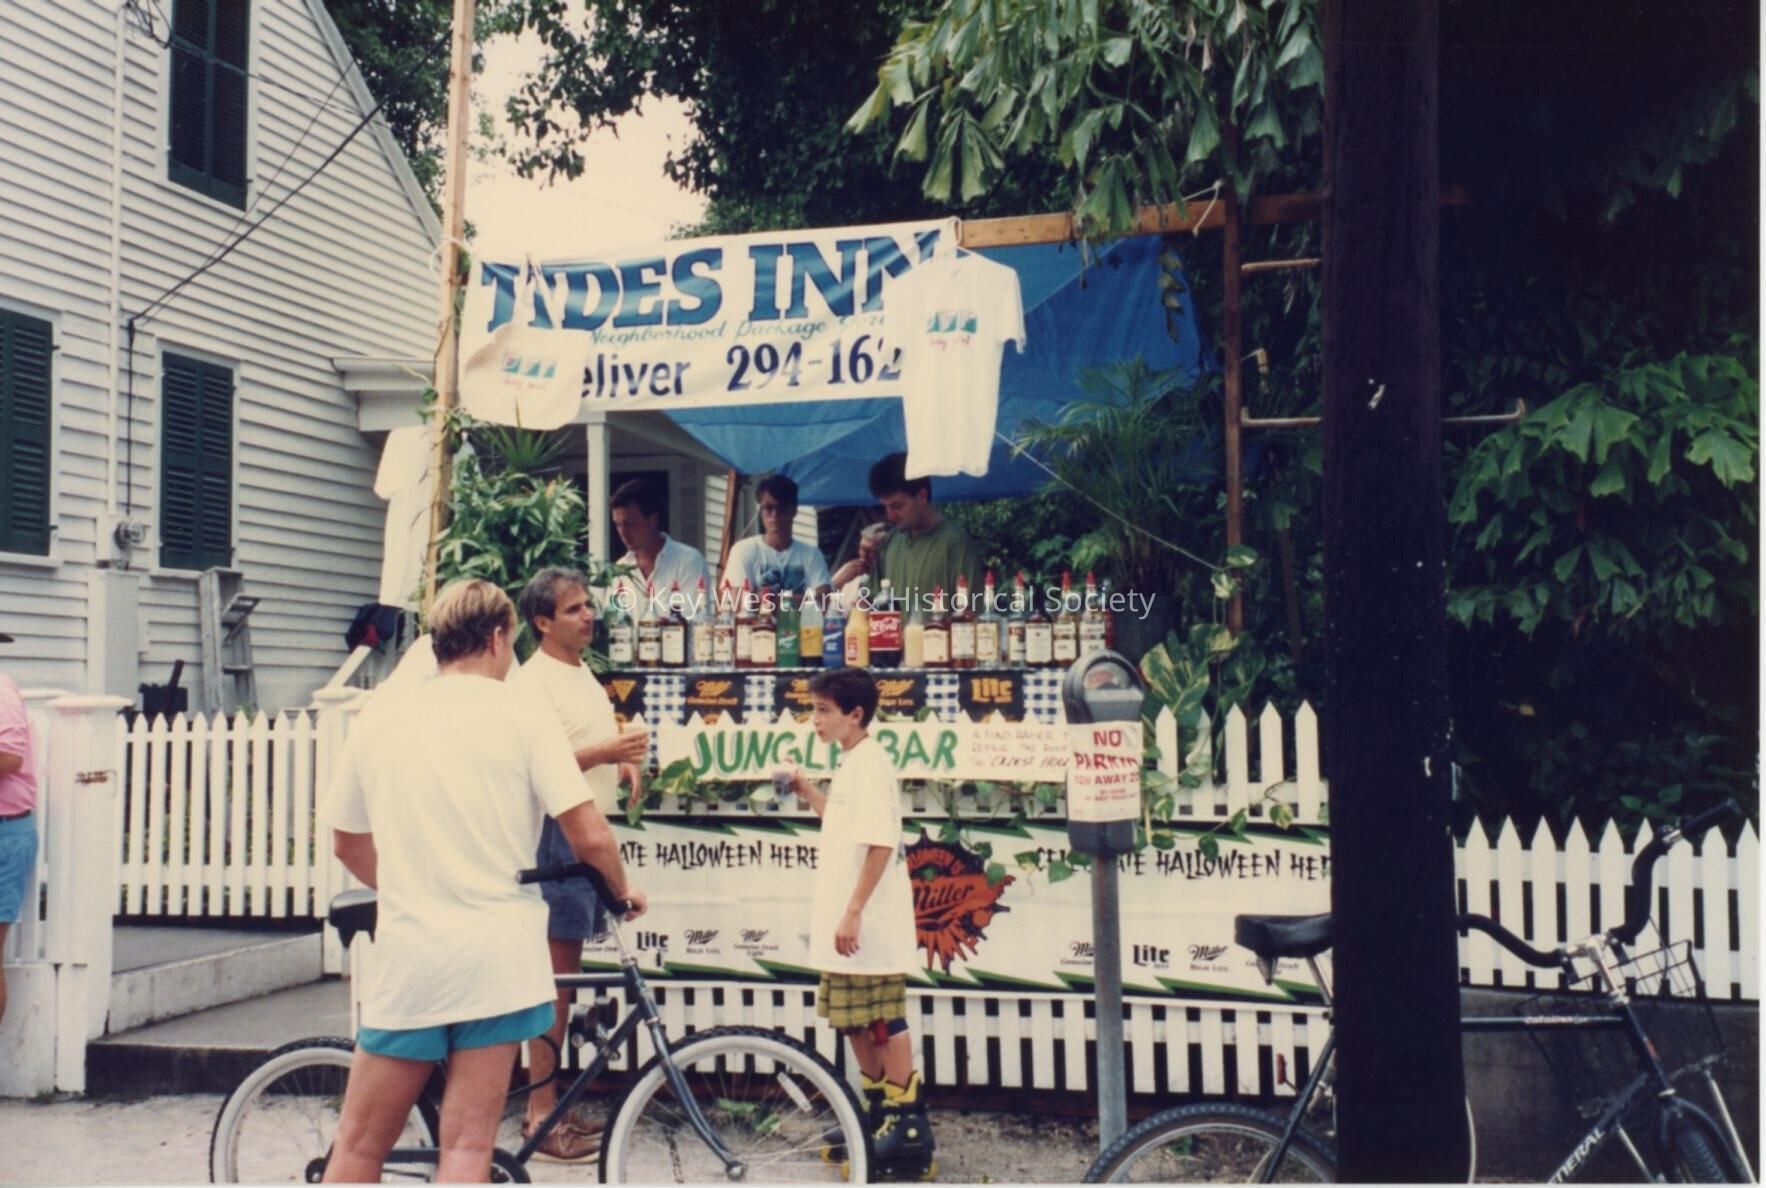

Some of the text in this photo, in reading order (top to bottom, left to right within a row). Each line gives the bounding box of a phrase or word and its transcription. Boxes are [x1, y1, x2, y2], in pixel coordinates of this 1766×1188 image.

[581, 334, 903, 399] eliver 294-162
[1093, 729, 1121, 747] NO
[1095, 774, 1127, 785] AWAY
[656, 840, 762, 870] HALLOWEEN
[770, 843, 819, 870] HERE
[1156, 848, 1281, 880] HALLOWEEN
[636, 931, 669, 951] Lite
[1133, 944, 1170, 966] Lite
[1188, 944, 1228, 961] Miller
